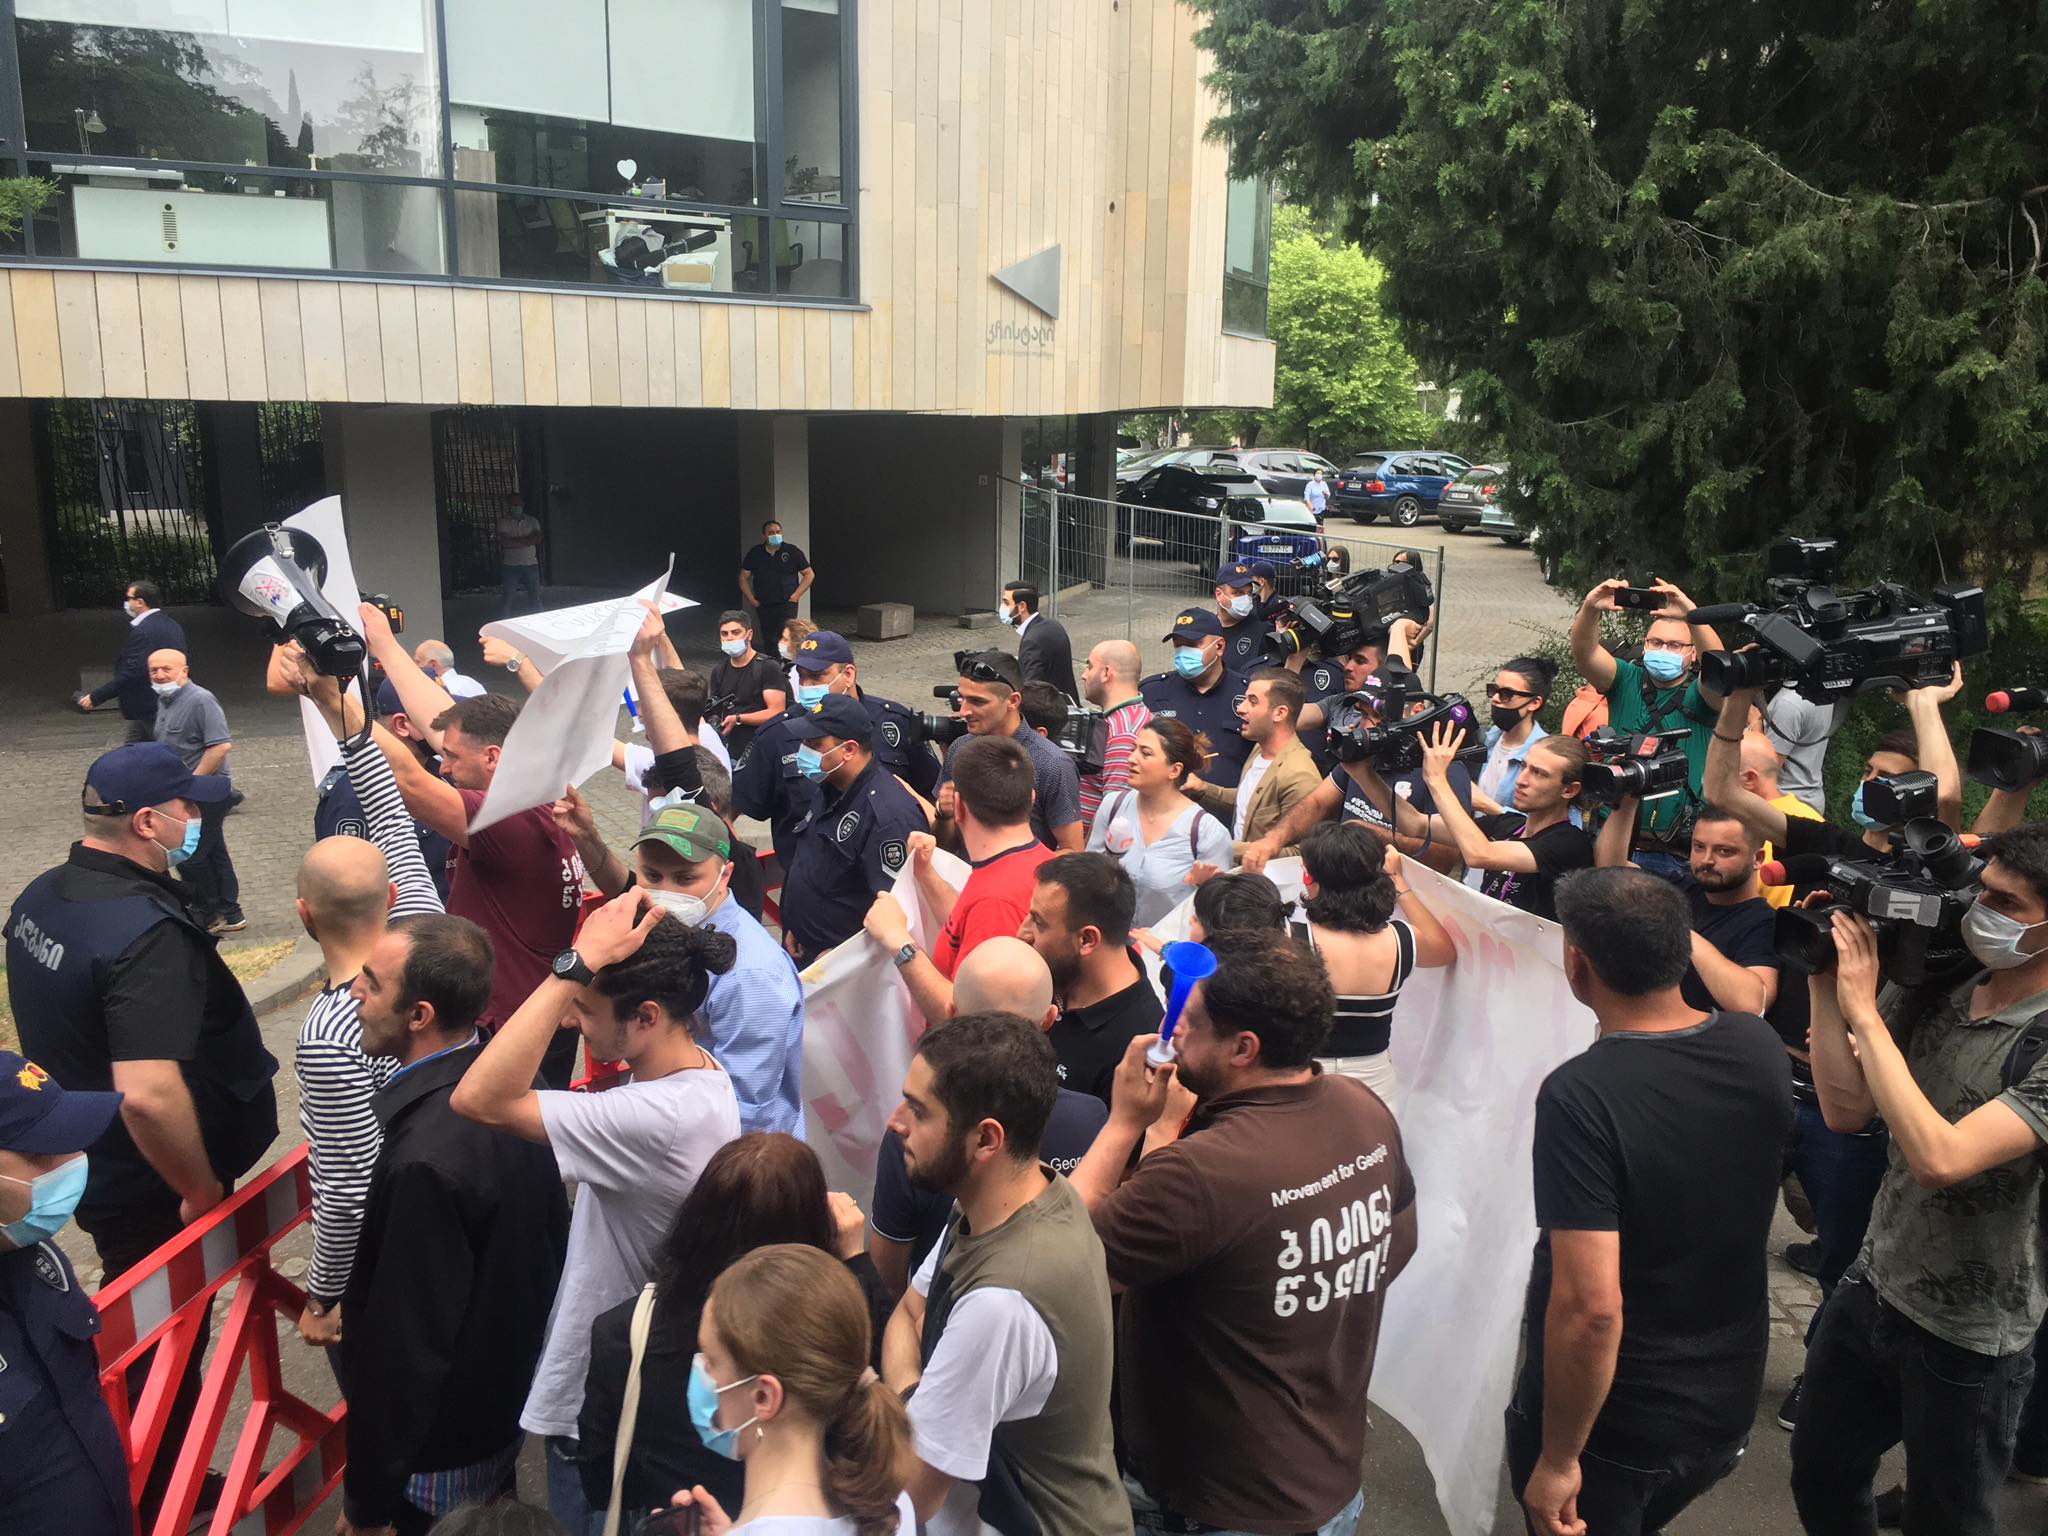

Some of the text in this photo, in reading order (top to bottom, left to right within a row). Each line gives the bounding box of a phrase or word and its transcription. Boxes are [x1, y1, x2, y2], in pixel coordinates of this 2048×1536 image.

[1338, 1163, 1355, 1180] for
[1277, 1184, 1392, 1270] ბიძინა
[1274, 1233, 1392, 1317] წადი!
